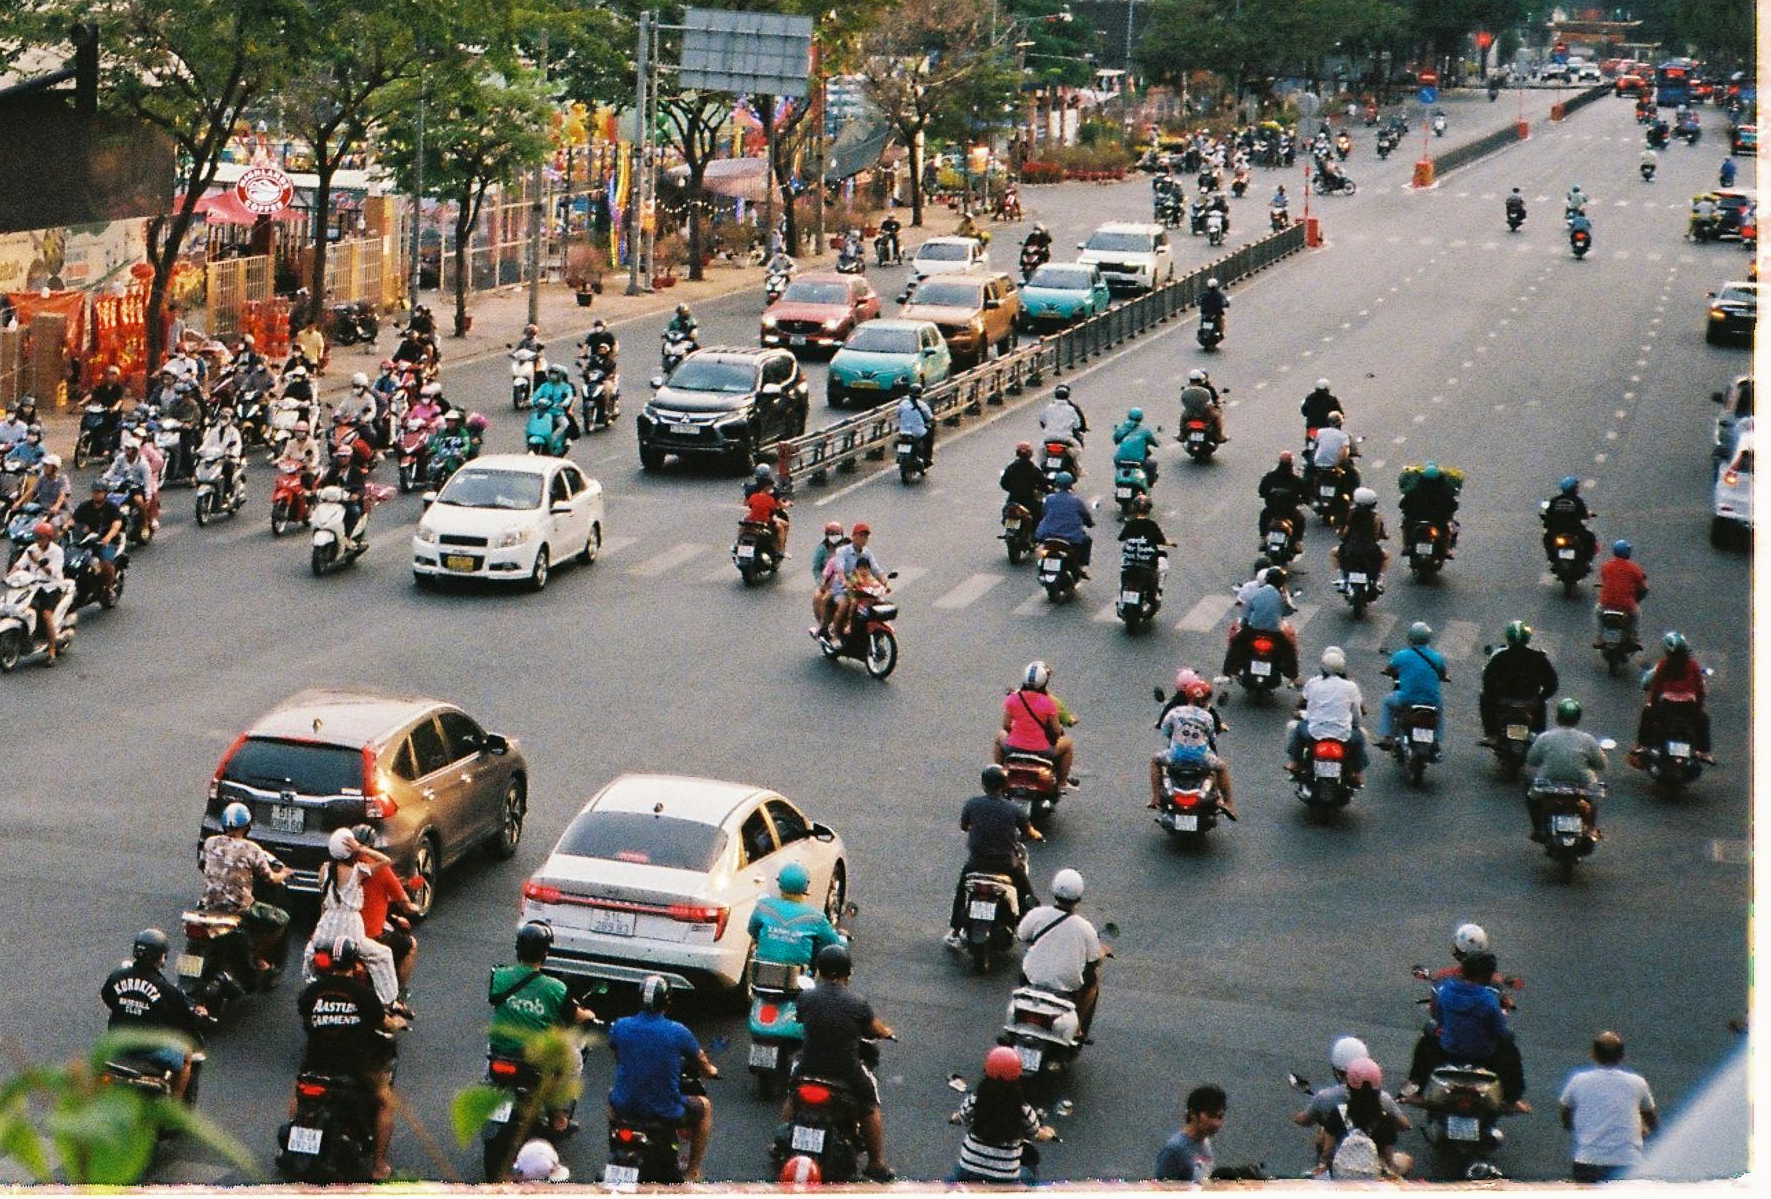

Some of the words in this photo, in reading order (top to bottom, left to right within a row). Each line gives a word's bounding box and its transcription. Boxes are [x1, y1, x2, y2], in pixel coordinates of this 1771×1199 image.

[239, 169, 289, 189] HIGHLANDS
[245, 200, 284, 212] COFFEE
[506, 994, 545, 1015] Grab
